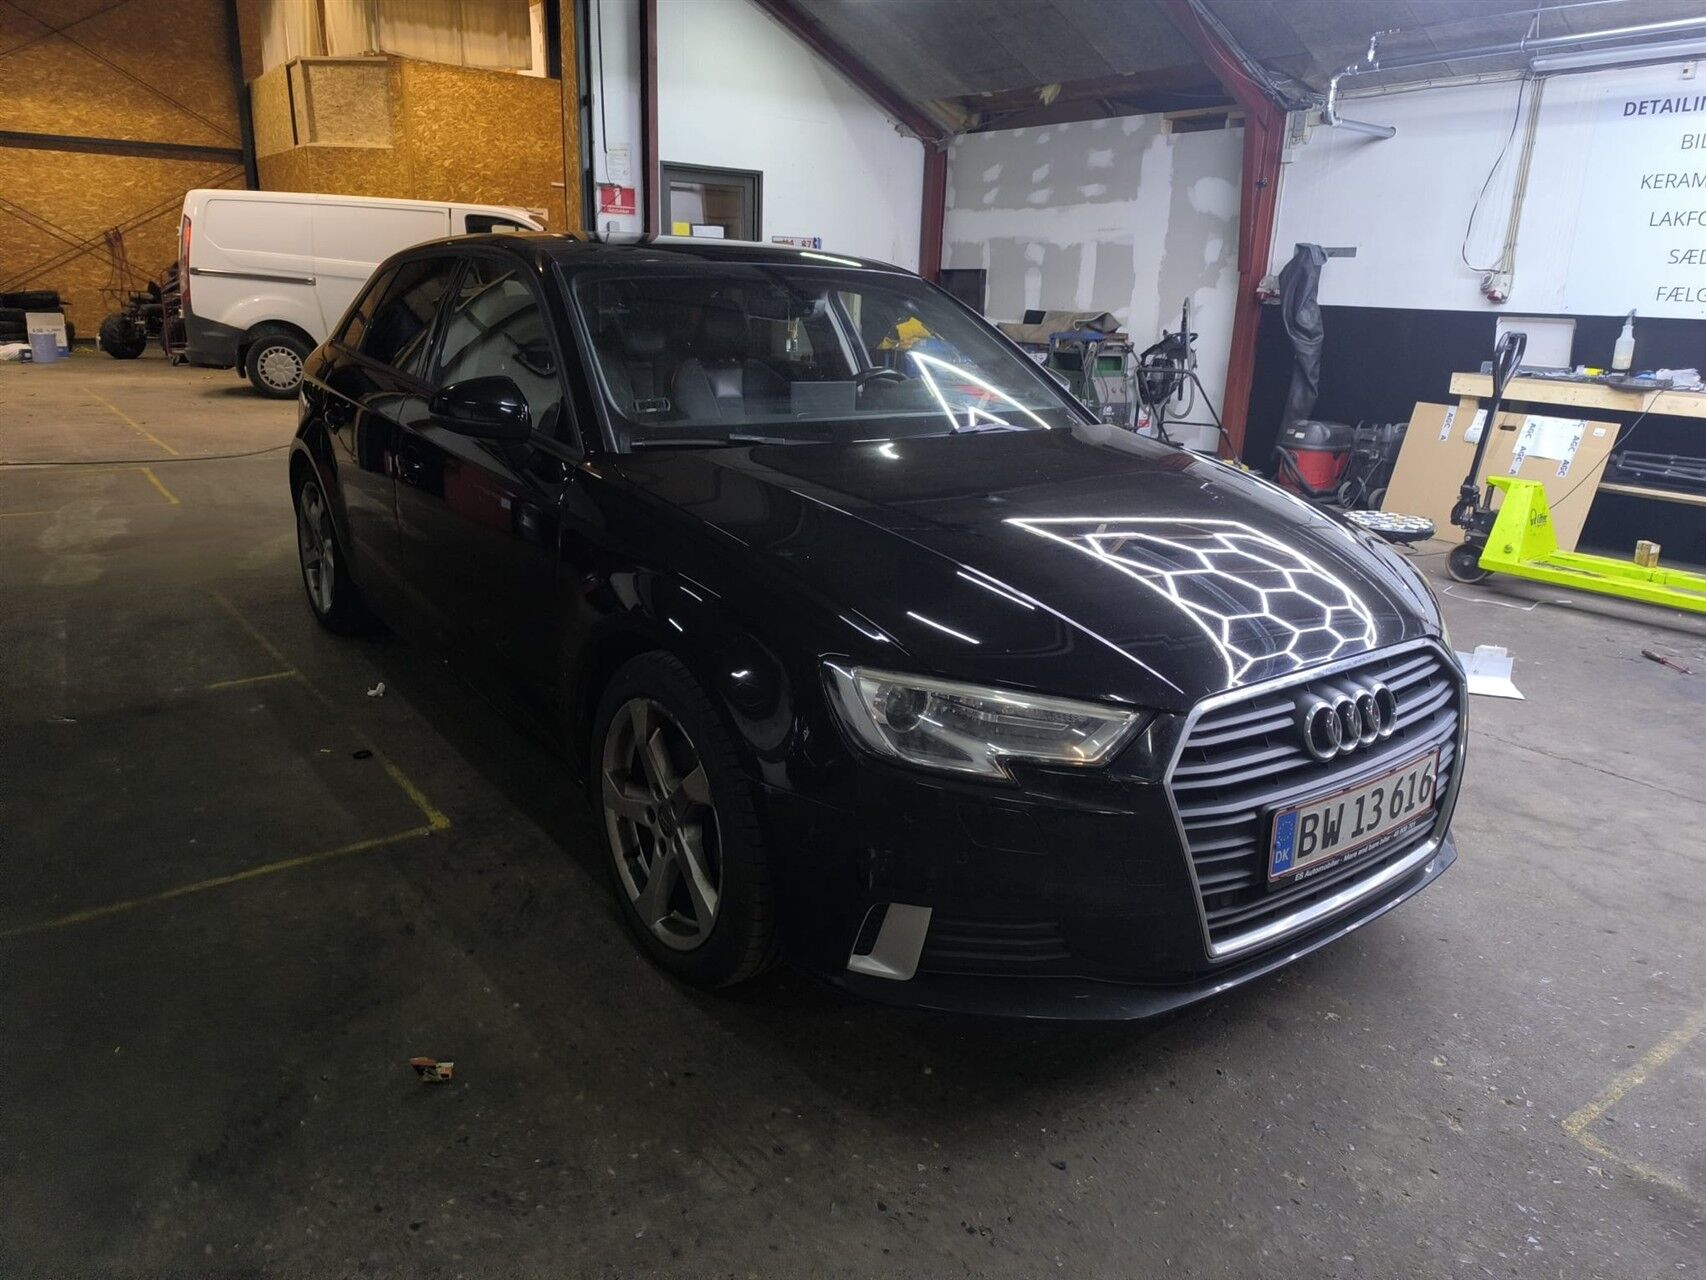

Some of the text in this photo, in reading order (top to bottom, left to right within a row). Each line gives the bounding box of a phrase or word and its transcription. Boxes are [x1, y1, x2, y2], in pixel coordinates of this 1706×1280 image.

[1525, 422, 1537, 439] AGC
[1515, 446, 1527, 463] AGC
[1557, 435, 1580, 477] AGC AGC
[1297, 761, 1433, 858] BW 13 616
[1275, 850, 1288, 864] DK
